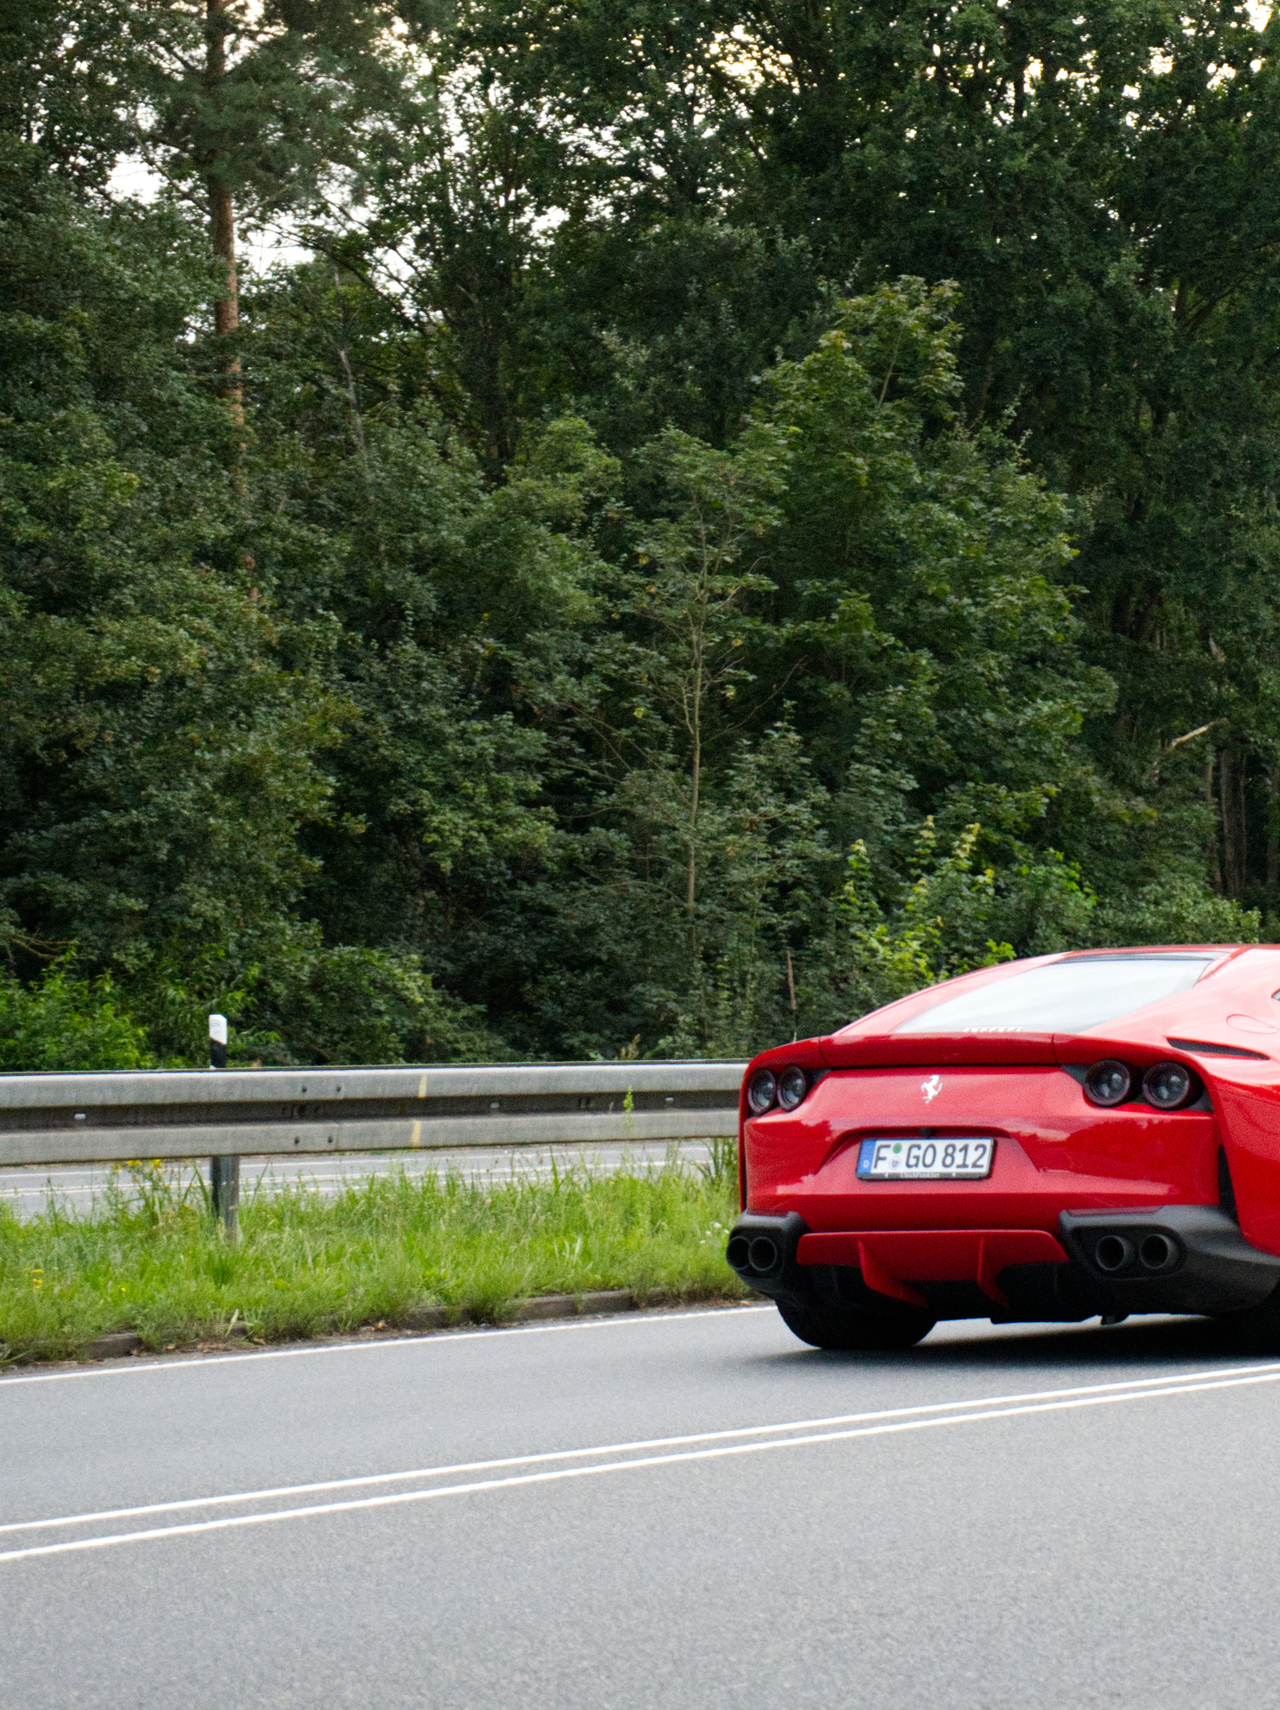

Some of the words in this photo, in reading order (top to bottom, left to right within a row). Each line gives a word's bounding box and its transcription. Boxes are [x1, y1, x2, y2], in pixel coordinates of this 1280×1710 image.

[863, 1159, 870, 1168] D
[873, 1143, 892, 1169] F
[905, 1143, 937, 1169] GO
[941, 1143, 987, 1169] 812
